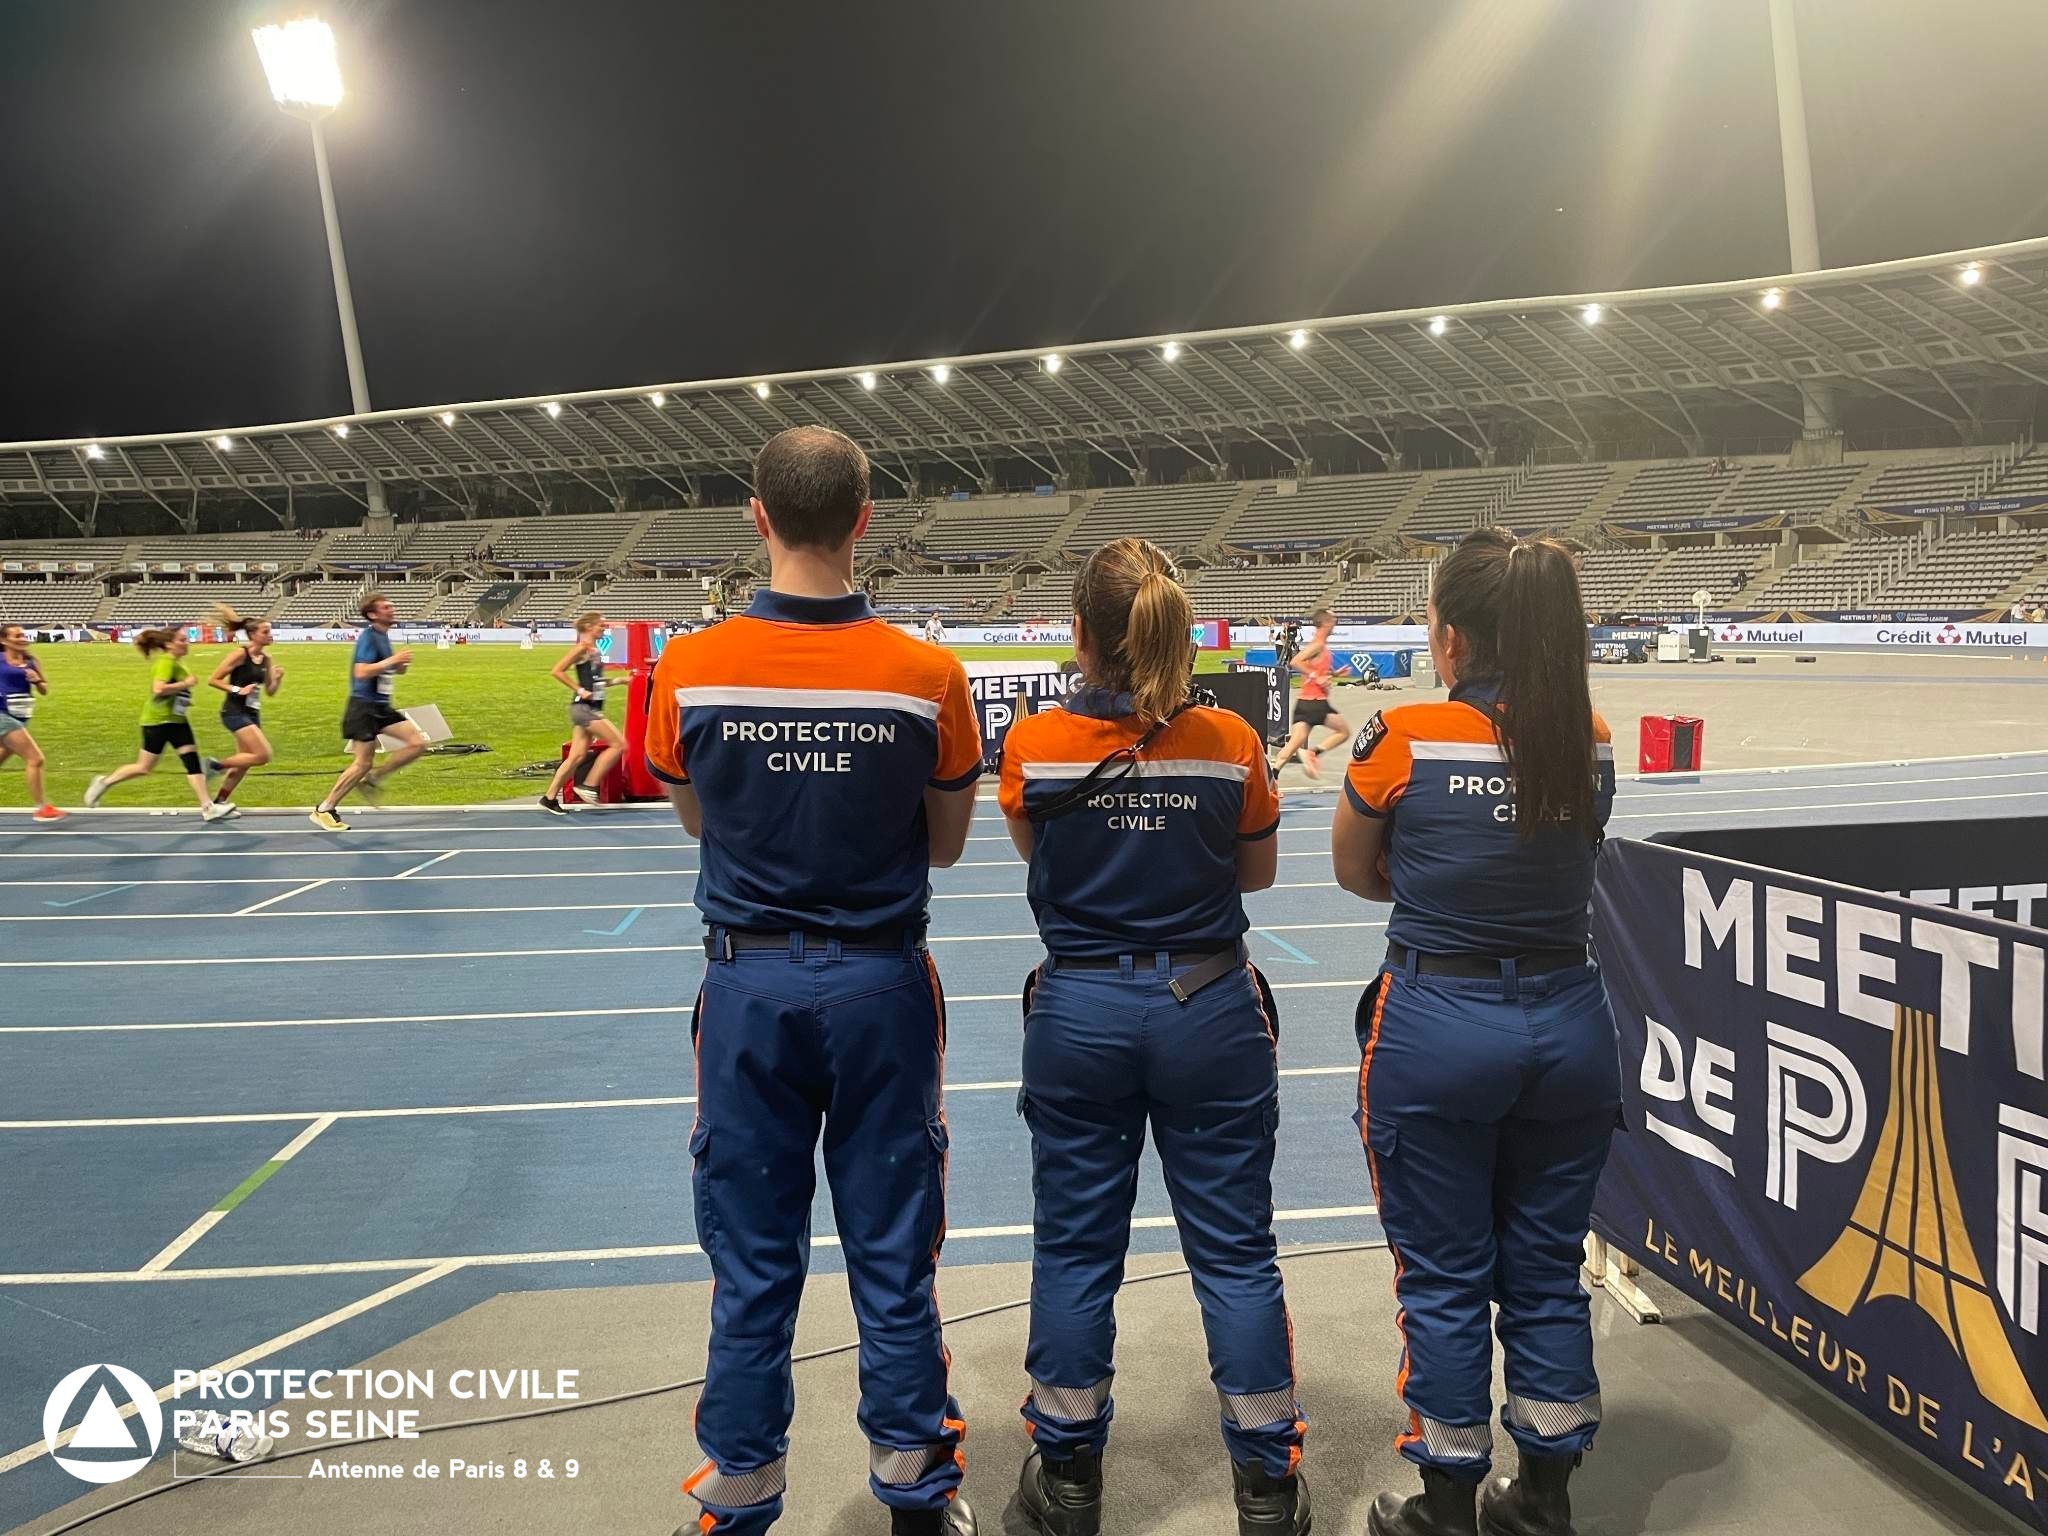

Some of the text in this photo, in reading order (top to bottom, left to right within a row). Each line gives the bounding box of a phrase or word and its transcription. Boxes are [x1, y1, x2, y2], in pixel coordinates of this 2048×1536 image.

[983, 632, 1018, 642] Crédit
[1747, 630, 1803, 642] Mutuel
[1877, 629, 2027, 646] Crédit Mutuel
[722, 721, 896, 744] PROTECTION
[766, 751, 852, 773] CIVILE
[1086, 793, 1197, 811] ROTECTION
[1107, 815, 1166, 831] CIVILE
[1639, 1014, 1736, 1137] DE
[1644, 1217, 2048, 1503] LE MEILLEUR DE L'A
